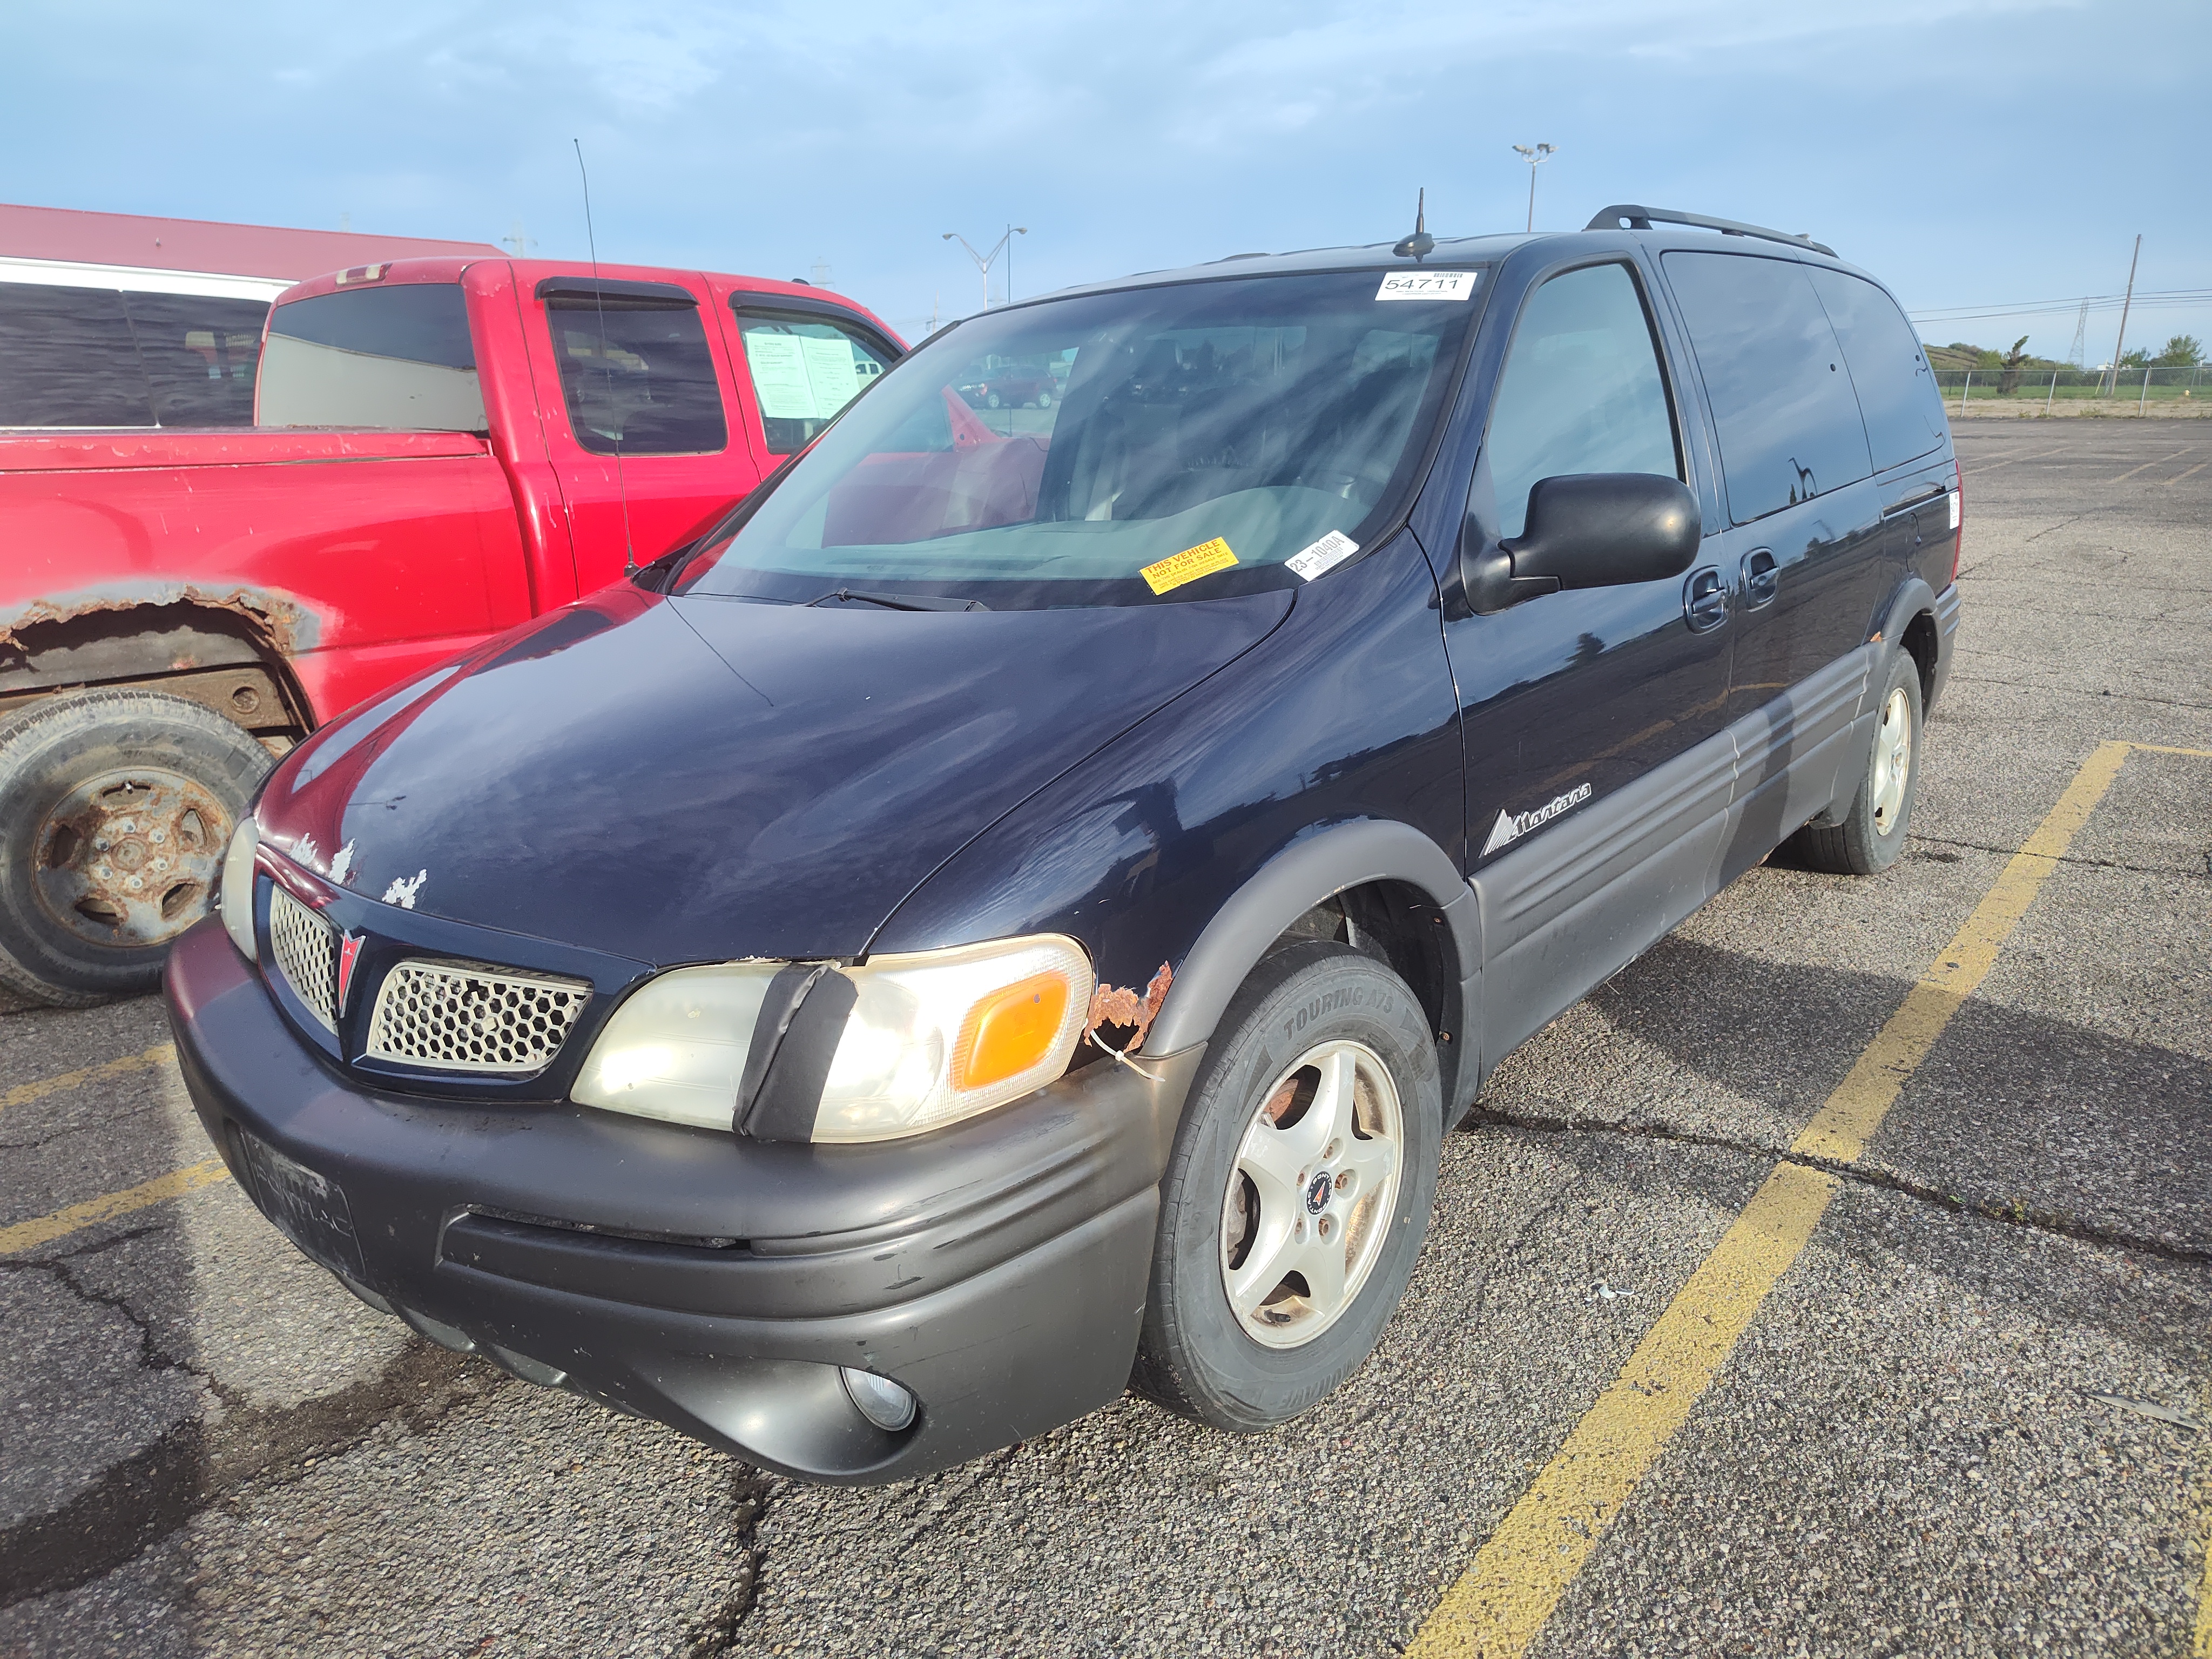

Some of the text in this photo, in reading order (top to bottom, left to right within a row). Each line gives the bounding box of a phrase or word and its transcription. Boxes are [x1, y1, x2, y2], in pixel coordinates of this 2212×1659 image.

[1385, 279, 1458, 290] 54711
[1145, 539, 1220, 574] THIS VEHICLE
[1152, 567, 1172, 578] NOT
[1174, 558, 1195, 569] FOR
[1196, 547, 1221, 561] SALE
[1171, 568, 1187, 576] DEALER
[1199, 556, 1216, 565] RESALE
[1290, 536, 1345, 572] 23-1040A
[1508, 782, 1592, 840] Montana
[1283, 987, 1363, 1041] TOURING
[1312, 1173, 1332, 1196] PONTIAC
[1307, 1191, 1327, 1213] PONTIAC
